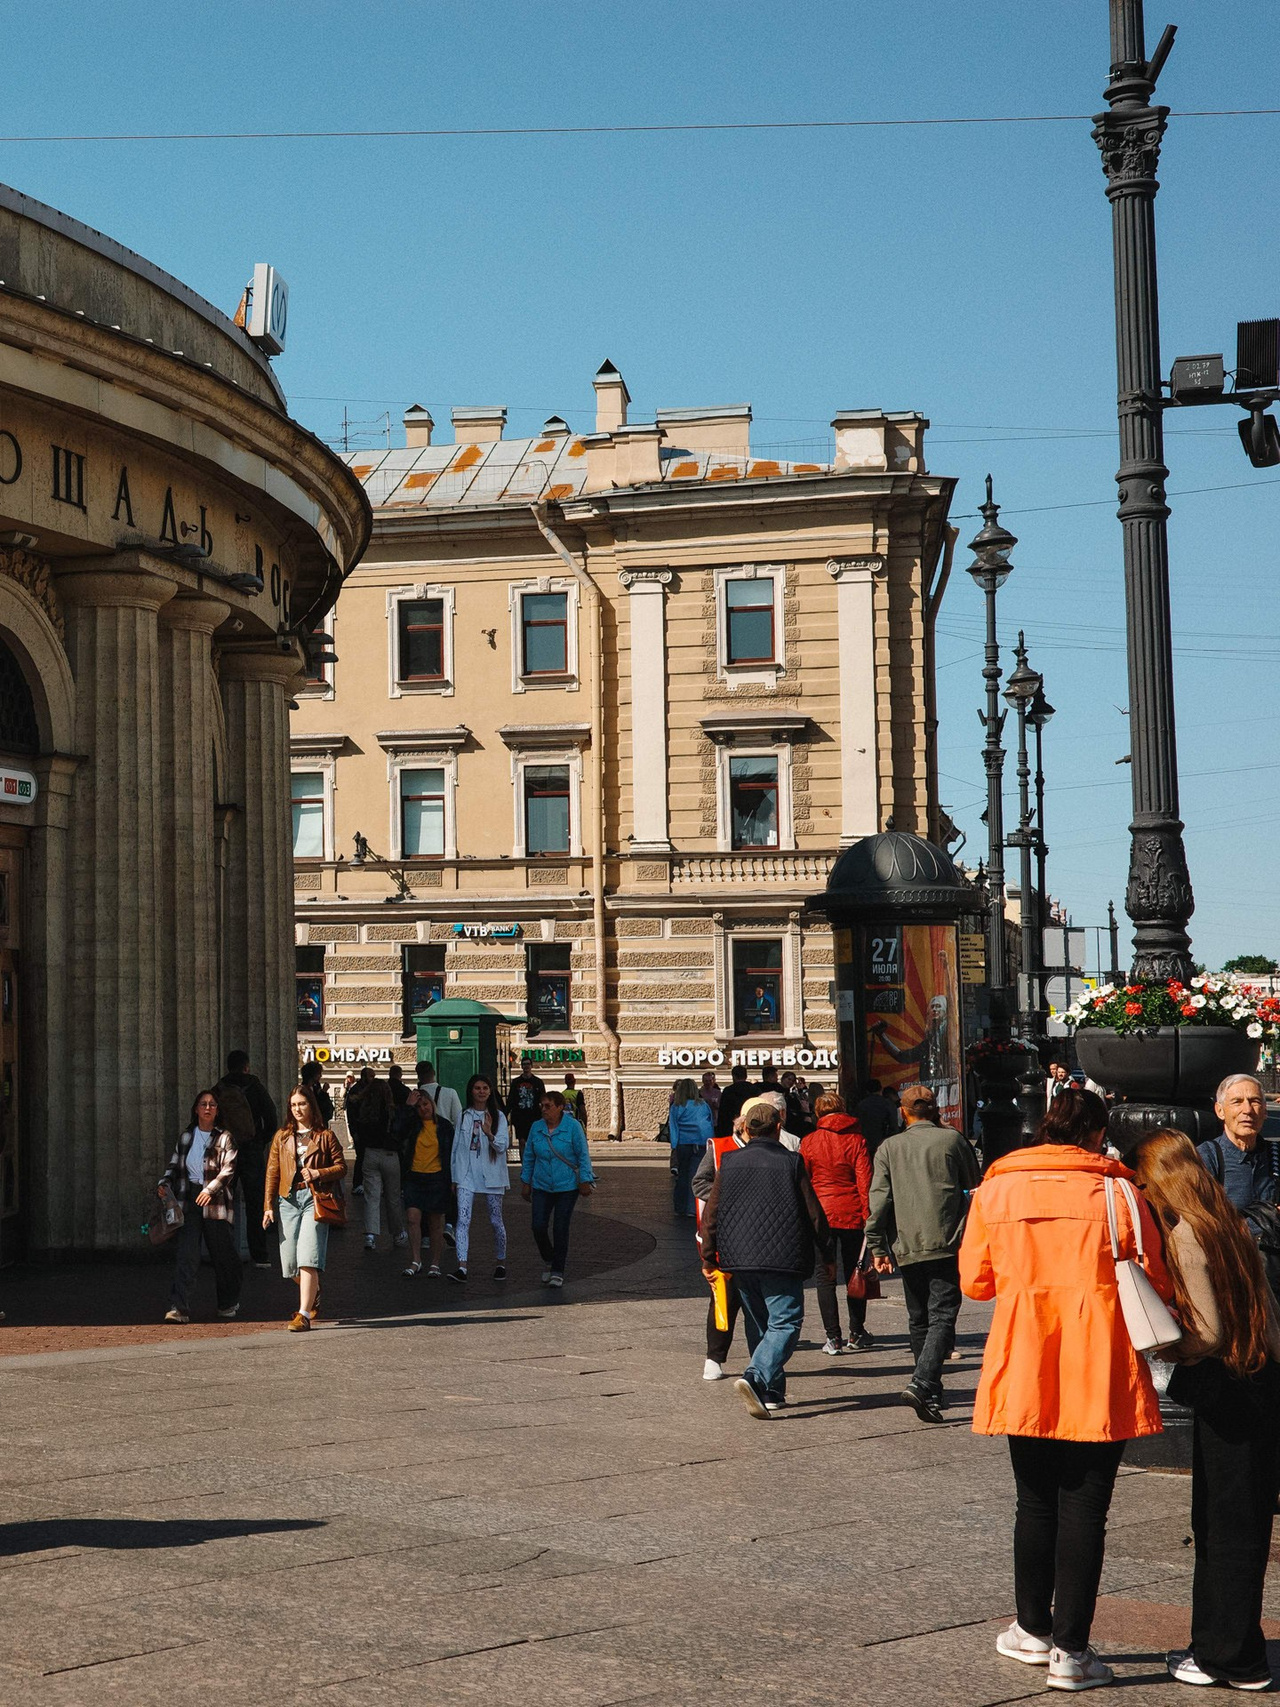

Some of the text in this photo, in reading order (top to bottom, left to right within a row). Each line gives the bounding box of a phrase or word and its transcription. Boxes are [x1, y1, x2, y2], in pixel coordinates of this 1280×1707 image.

[463, 926, 488, 937] VTB
[872, 937, 898, 962] 27
[872, 963, 898, 975] ИЮЛЯ
[302, 1048, 391, 1063] ЛОМБАРД
[658, 1049, 724, 1067] БЮРО
